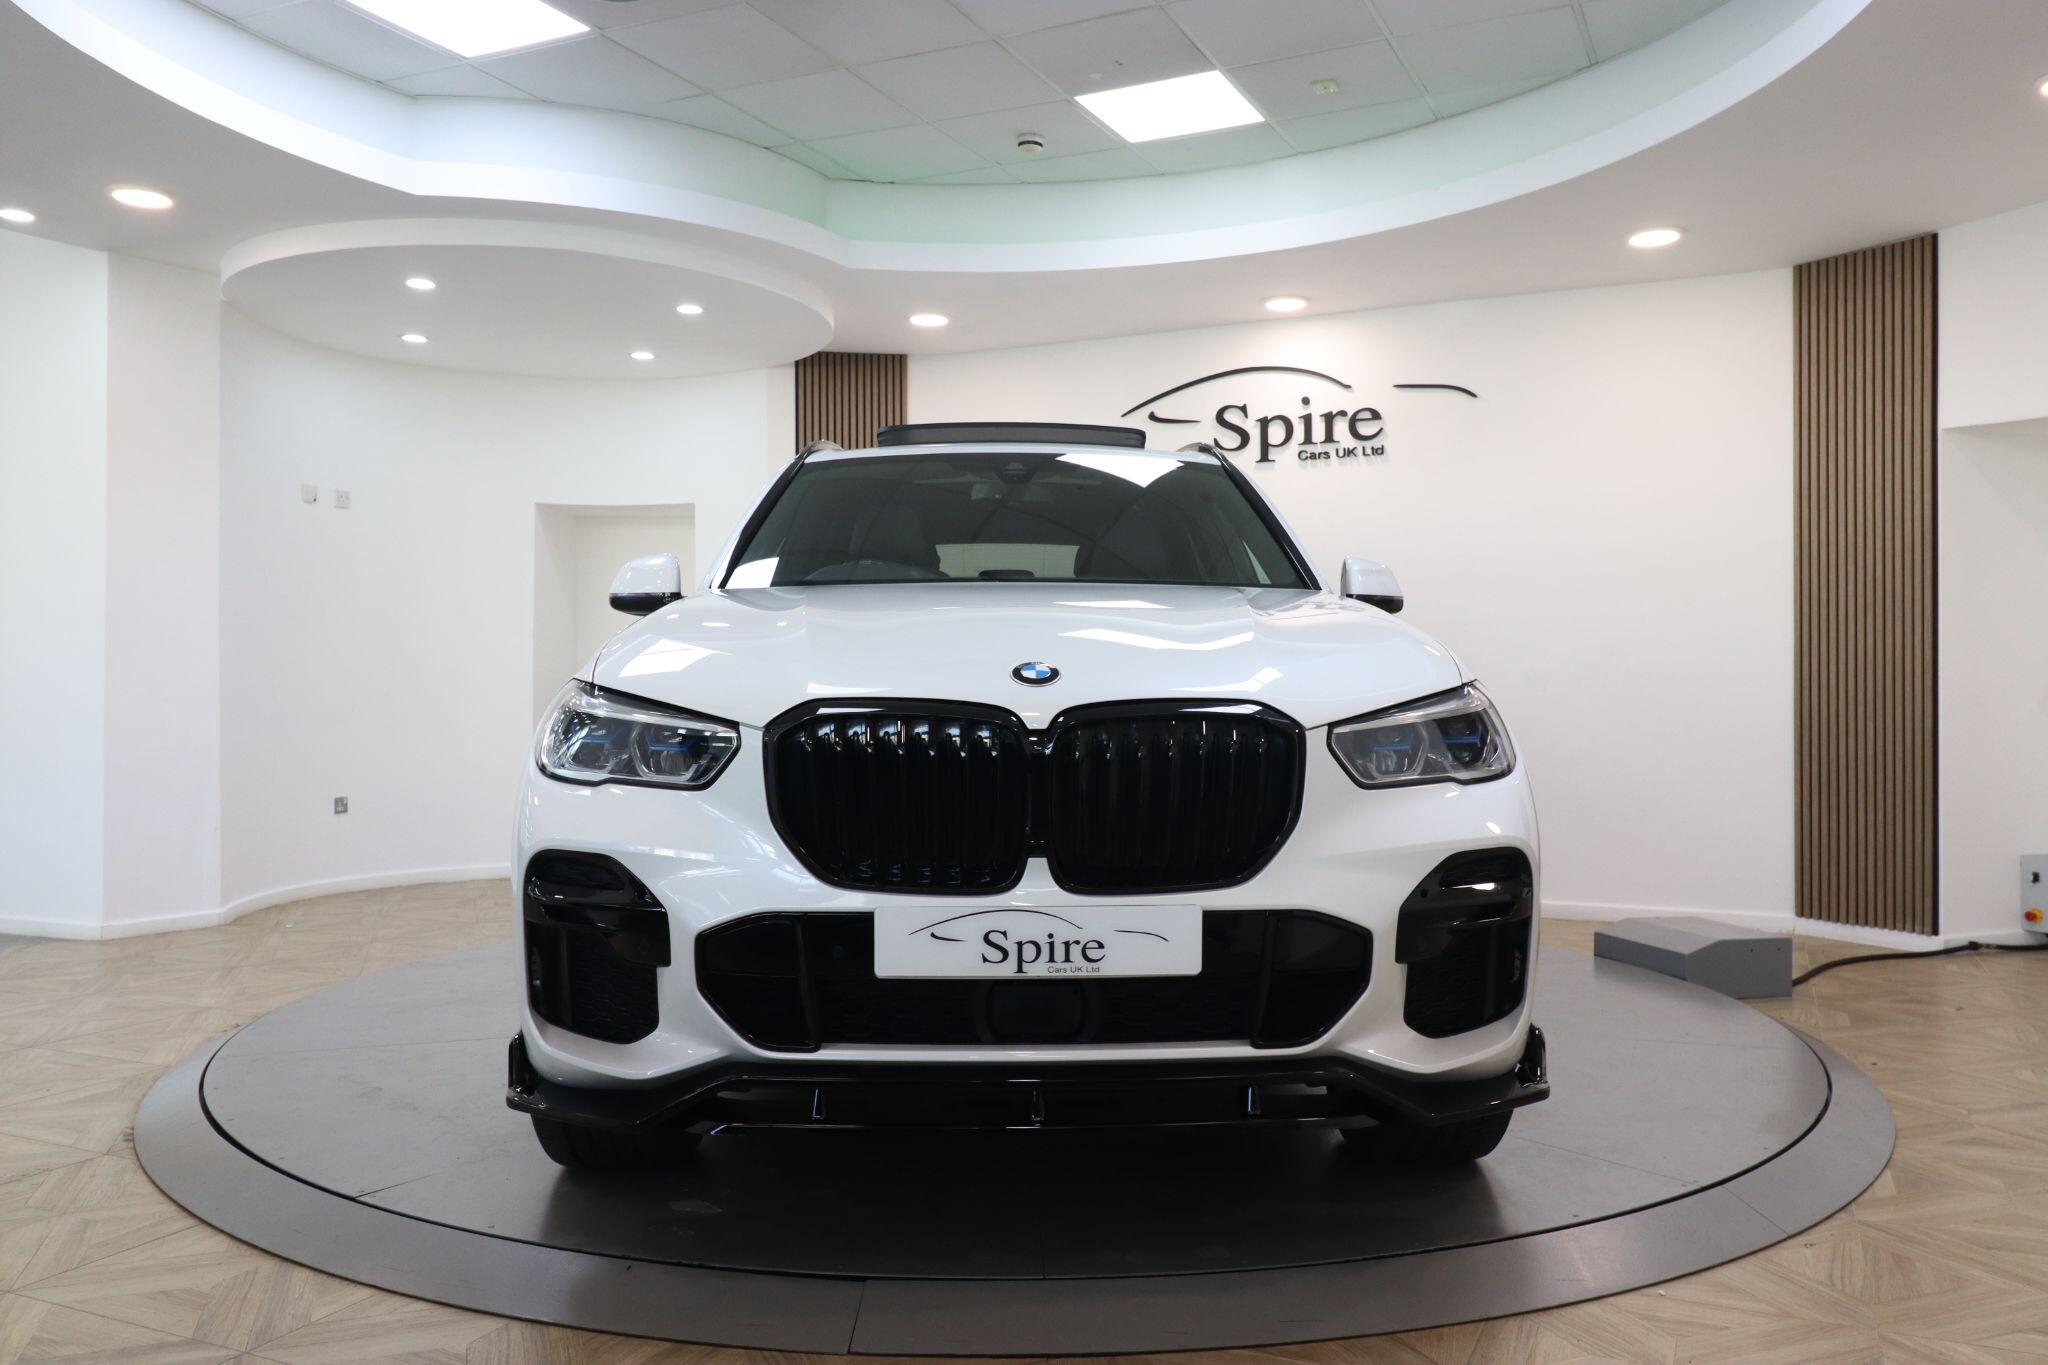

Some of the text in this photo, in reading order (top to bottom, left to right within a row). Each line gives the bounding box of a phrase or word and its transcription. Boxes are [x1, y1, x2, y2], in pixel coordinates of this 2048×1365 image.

[1213, 396, 1384, 463] Spire
[1297, 444, 1384, 461] Cars UK Ltd
[981, 929, 1106, 974] Spire
[1047, 965, 1100, 974] Cars UK Ltd
